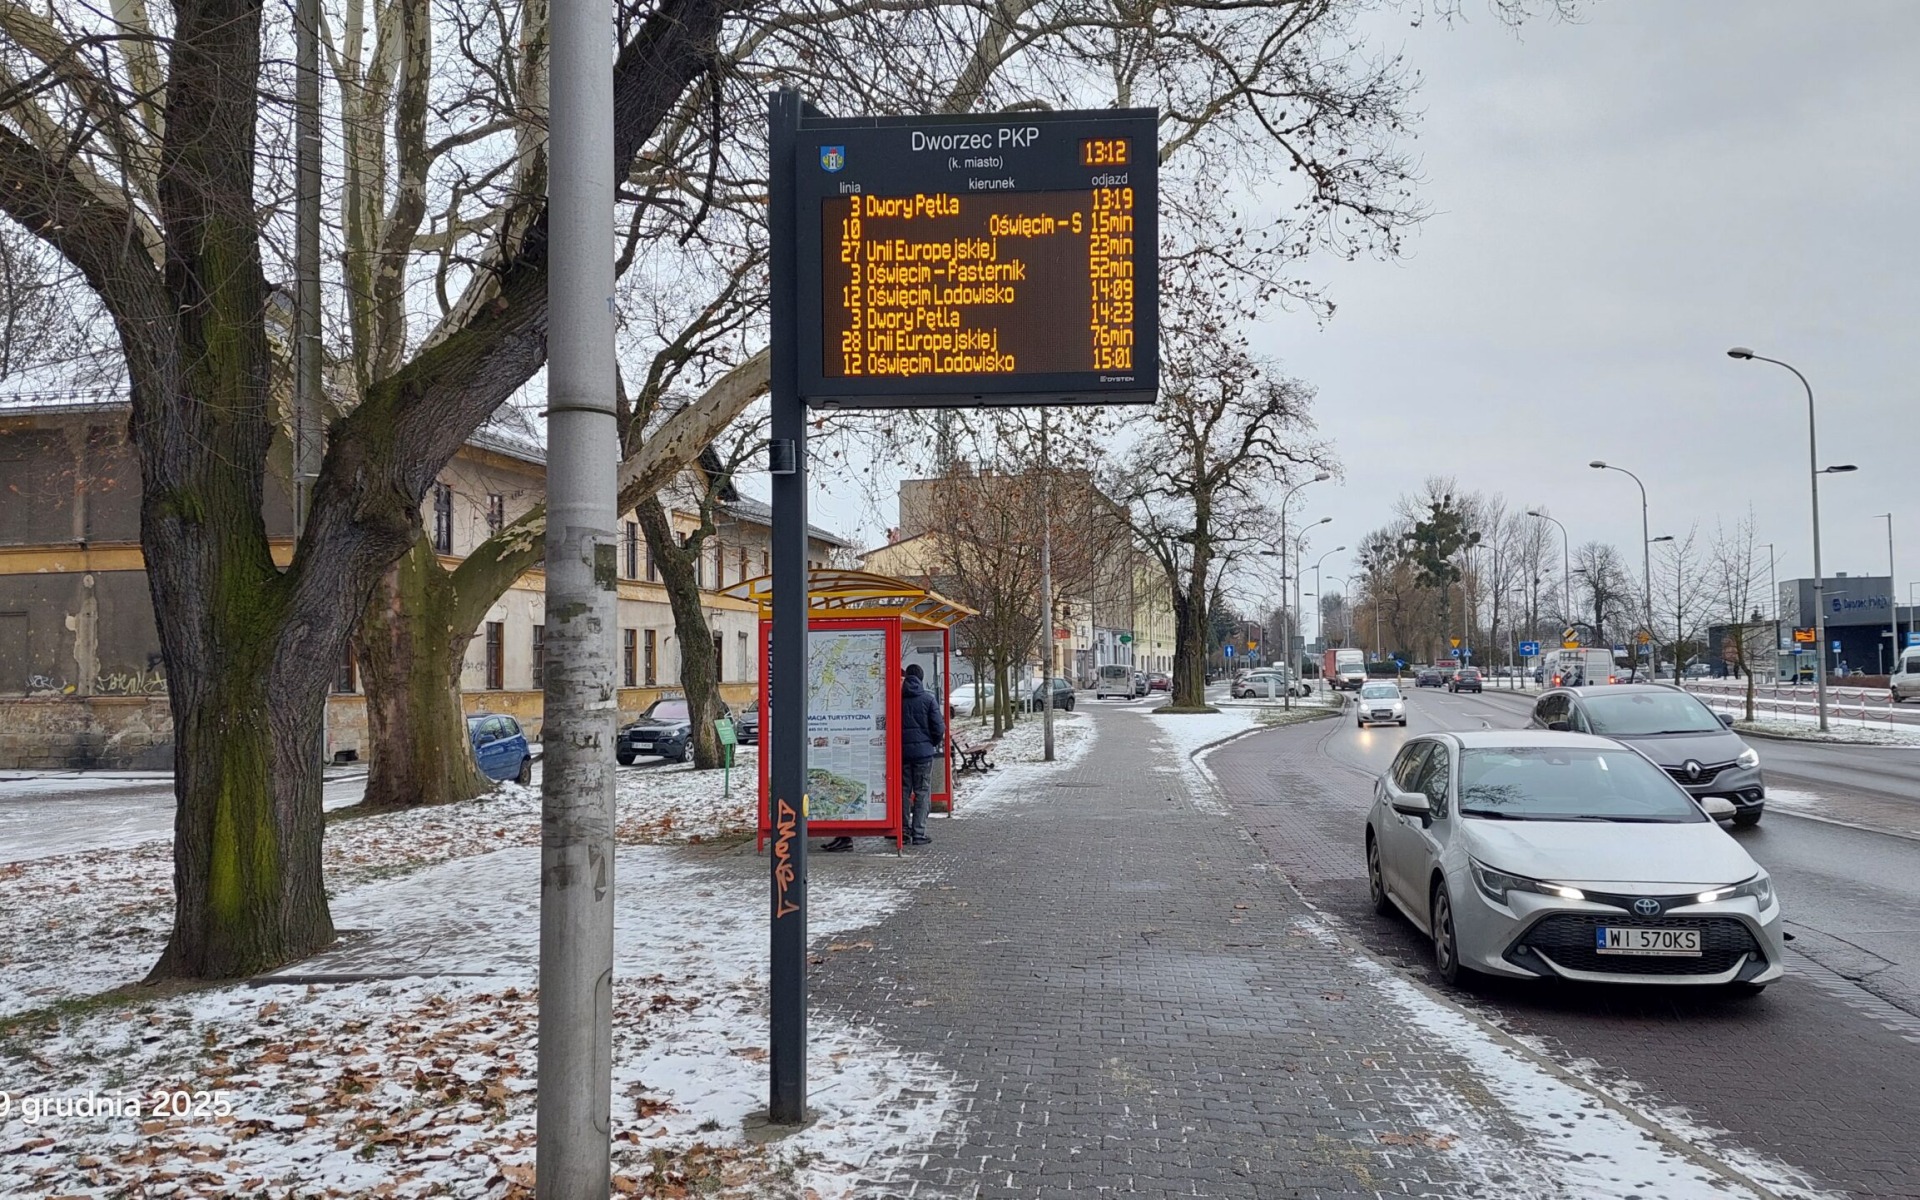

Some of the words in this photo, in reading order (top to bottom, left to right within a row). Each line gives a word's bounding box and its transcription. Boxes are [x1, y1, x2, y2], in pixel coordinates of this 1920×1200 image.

[912, 131, 993, 151] Dworzec
[998, 127, 1040, 148] PKP
[1086, 140, 1126, 163] 13:12
[948, 157, 961, 171] (k.
[964, 155, 1003, 169] miasto)
[839, 180, 861, 193] linia
[968, 176, 1015, 189] kierunek
[1091, 172, 1128, 188] odjazd
[850, 195, 860, 217] 3
[866, 195, 912, 219] Dwory
[916, 193, 960, 218] Pętla
[1093, 188, 1133, 210] 13:19
[843, 218, 861, 240] 10
[989, 214, 1055, 236] Oświęcim
[1072, 212, 1082, 234] S
[1091, 211, 1133, 232] 15min
[842, 240, 860, 262] 27
[866, 240, 892, 262] Unii
[895, 238, 997, 263] Europejskiej
[1090, 234, 1133, 256] 23min
[851, 263, 861, 284] 3
[866, 262, 930, 288] Oświęcim
[948, 259, 1026, 282] Pasternik
[1090, 256, 1133, 278] 52min
[843, 286, 861, 307] 12
[867, 285, 930, 308] Oświęcim
[934, 282, 1014, 306] Lodowisko
[1092, 279, 1133, 301] 14:09
[852, 308, 861, 330] 3
[867, 308, 914, 331] Dwory
[916, 306, 960, 330] Pętla
[1092, 302, 1133, 323] 14:23
[842, 331, 861, 352] 28
[867, 330, 893, 352] Unii
[896, 328, 998, 354] Europejskiej
[1090, 324, 1133, 346] 76min
[844, 354, 862, 374] 12
[867, 352, 931, 377] Oświęcim
[934, 351, 1014, 374] Lodowisko
[1094, 346, 1132, 369] 15:01
[1610, 930, 1630, 947] WI
[1640, 932, 1696, 949] 570KS
